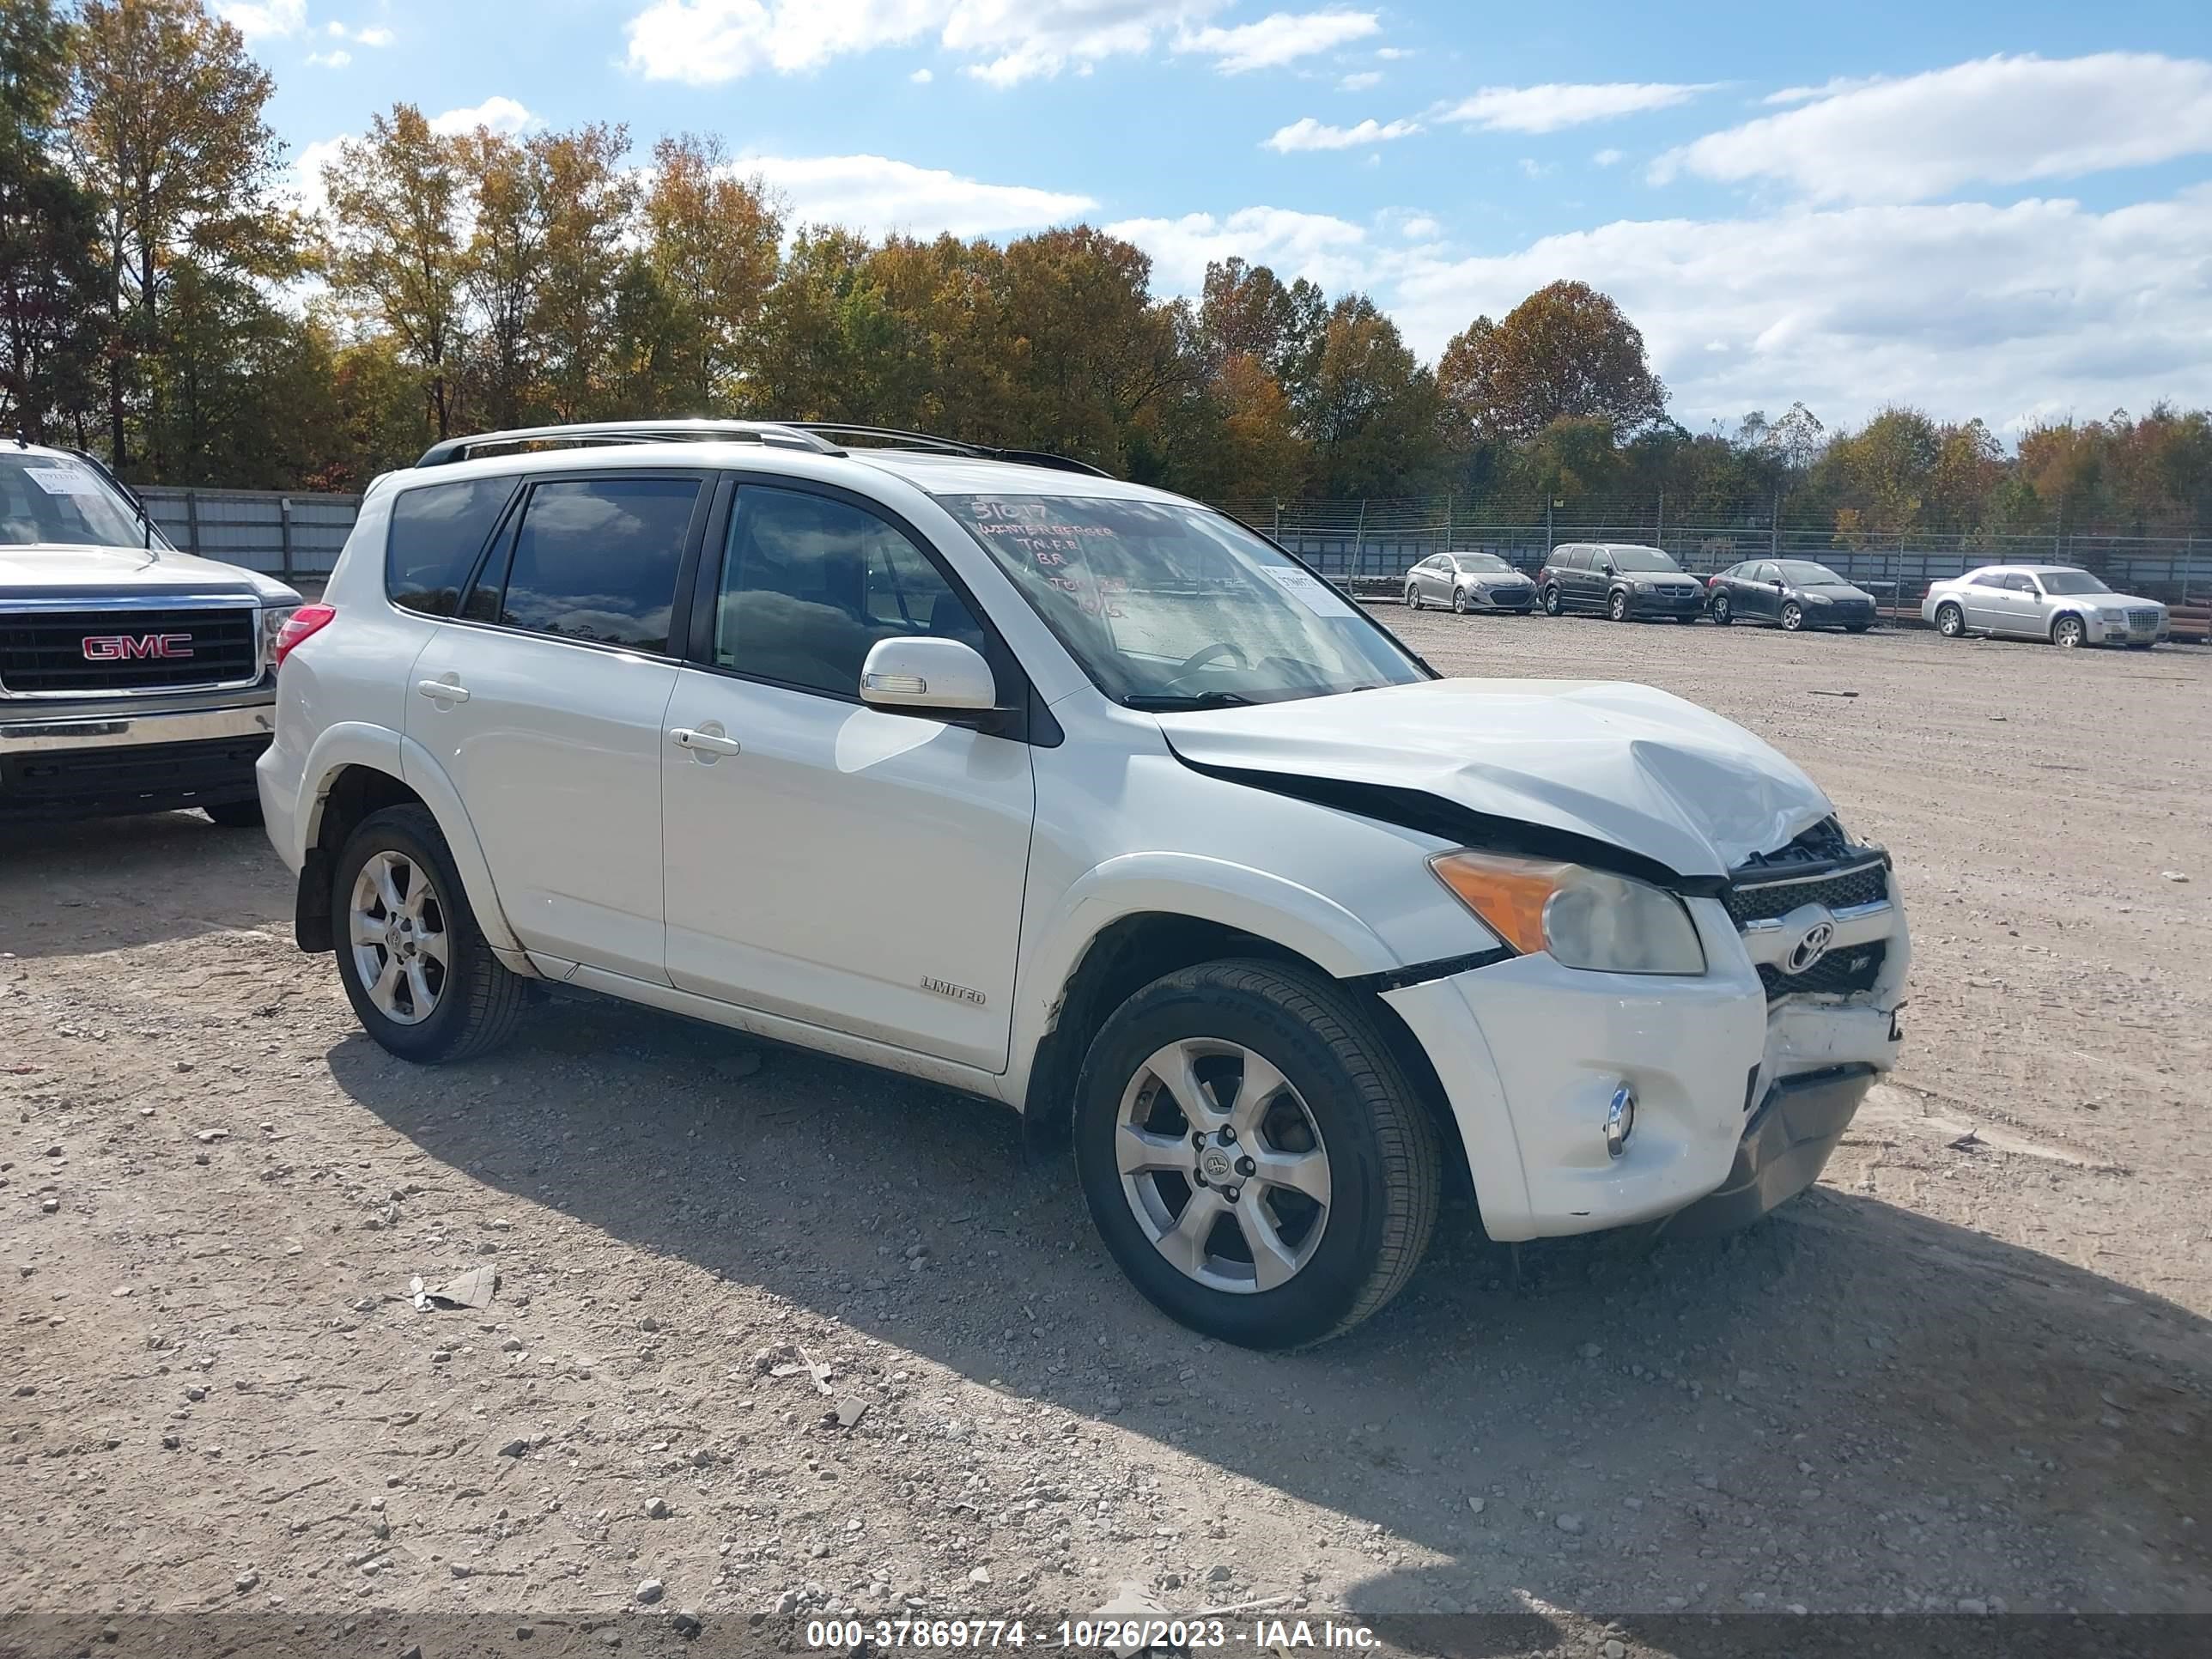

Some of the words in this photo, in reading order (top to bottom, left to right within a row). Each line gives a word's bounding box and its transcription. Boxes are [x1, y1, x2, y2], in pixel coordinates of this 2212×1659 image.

[971, 501, 1047, 520] 31017
[82, 634, 193, 660] GMC
[921, 975, 986, 1005] LIMITED
